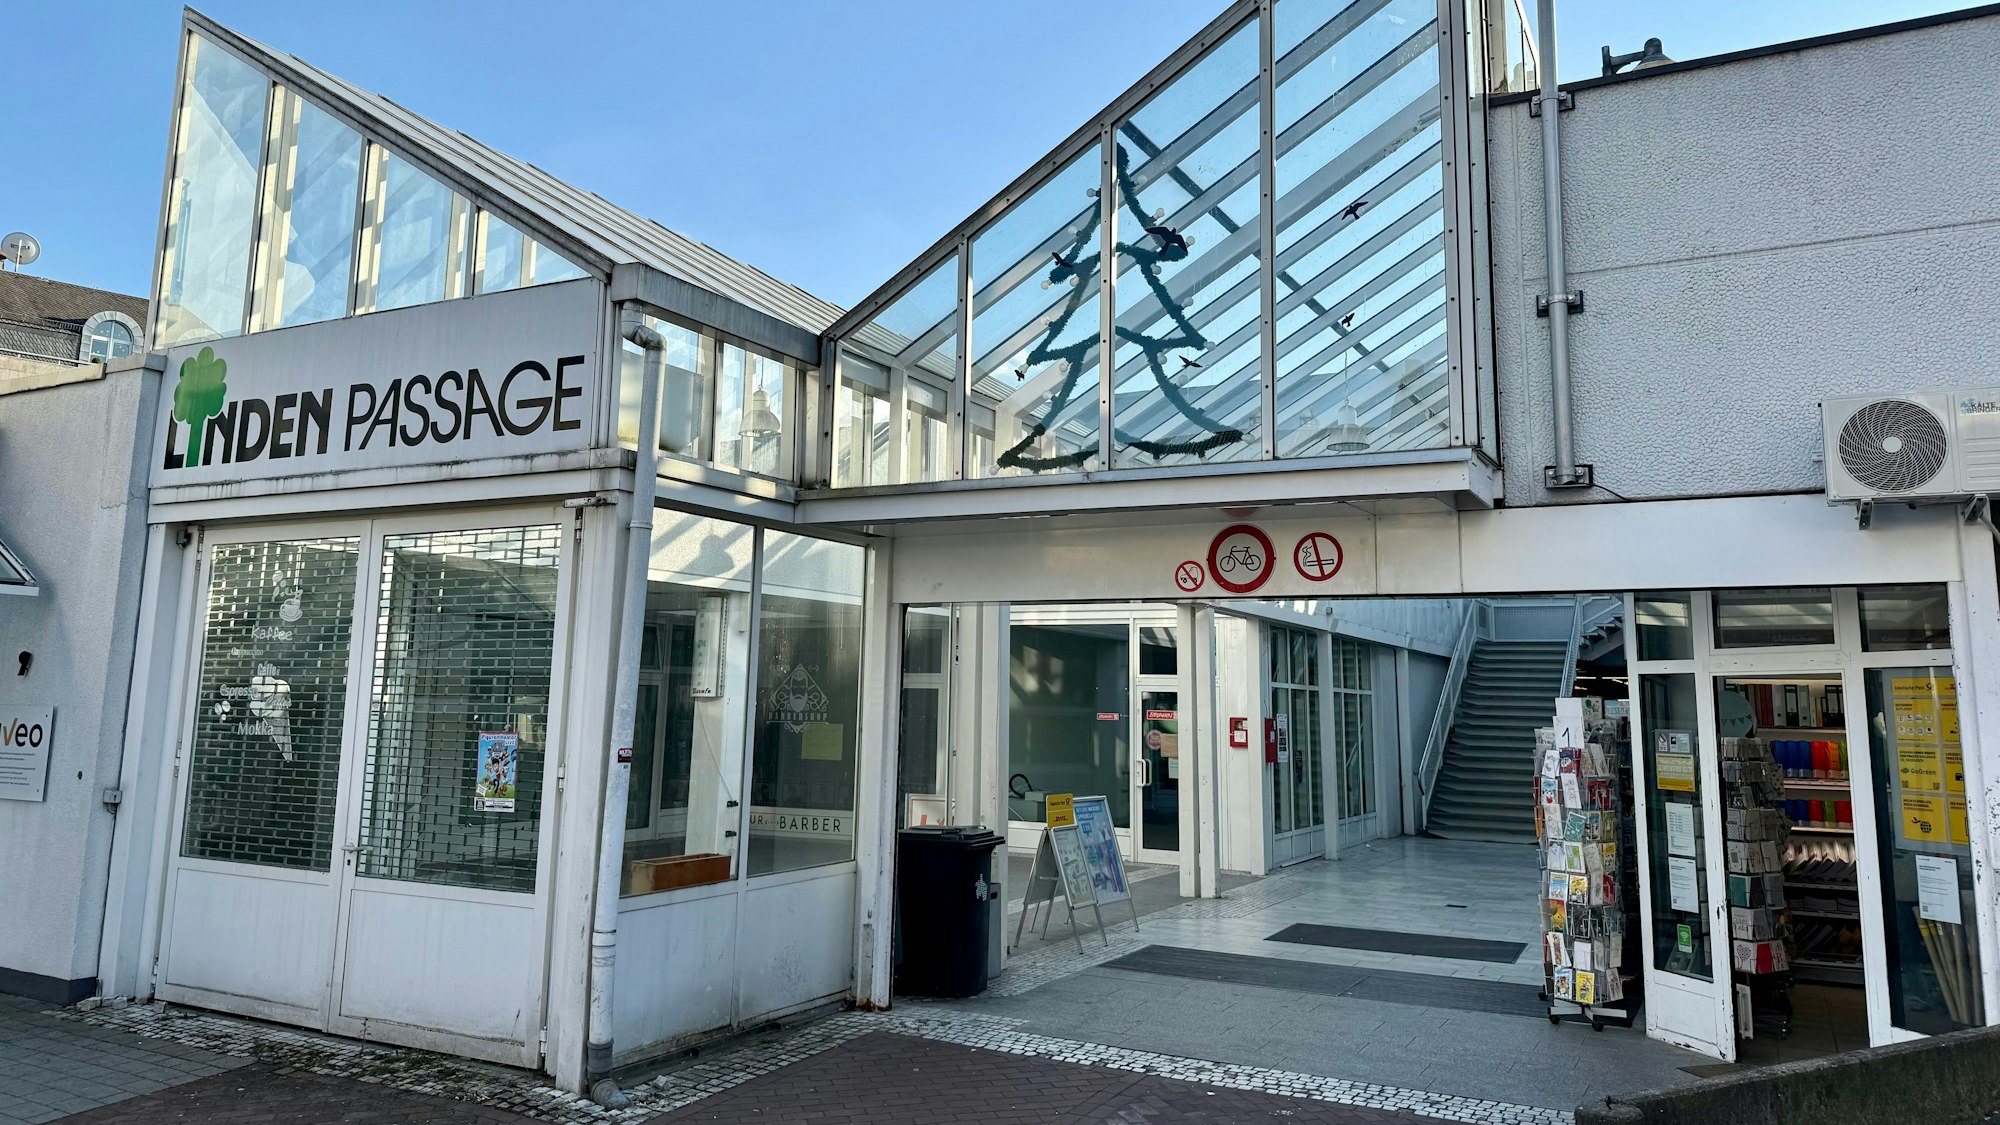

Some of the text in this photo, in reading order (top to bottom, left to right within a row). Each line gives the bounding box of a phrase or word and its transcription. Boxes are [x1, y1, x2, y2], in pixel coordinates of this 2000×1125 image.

[344, 355, 585, 451] PASSAGE
[251, 624, 293, 641] Kaffee
[220, 683, 260, 700] Espresso
[0, 718, 43, 748] veo
[237, 720, 274, 735] Mokka
[779, 816, 841, 832] BARBER
